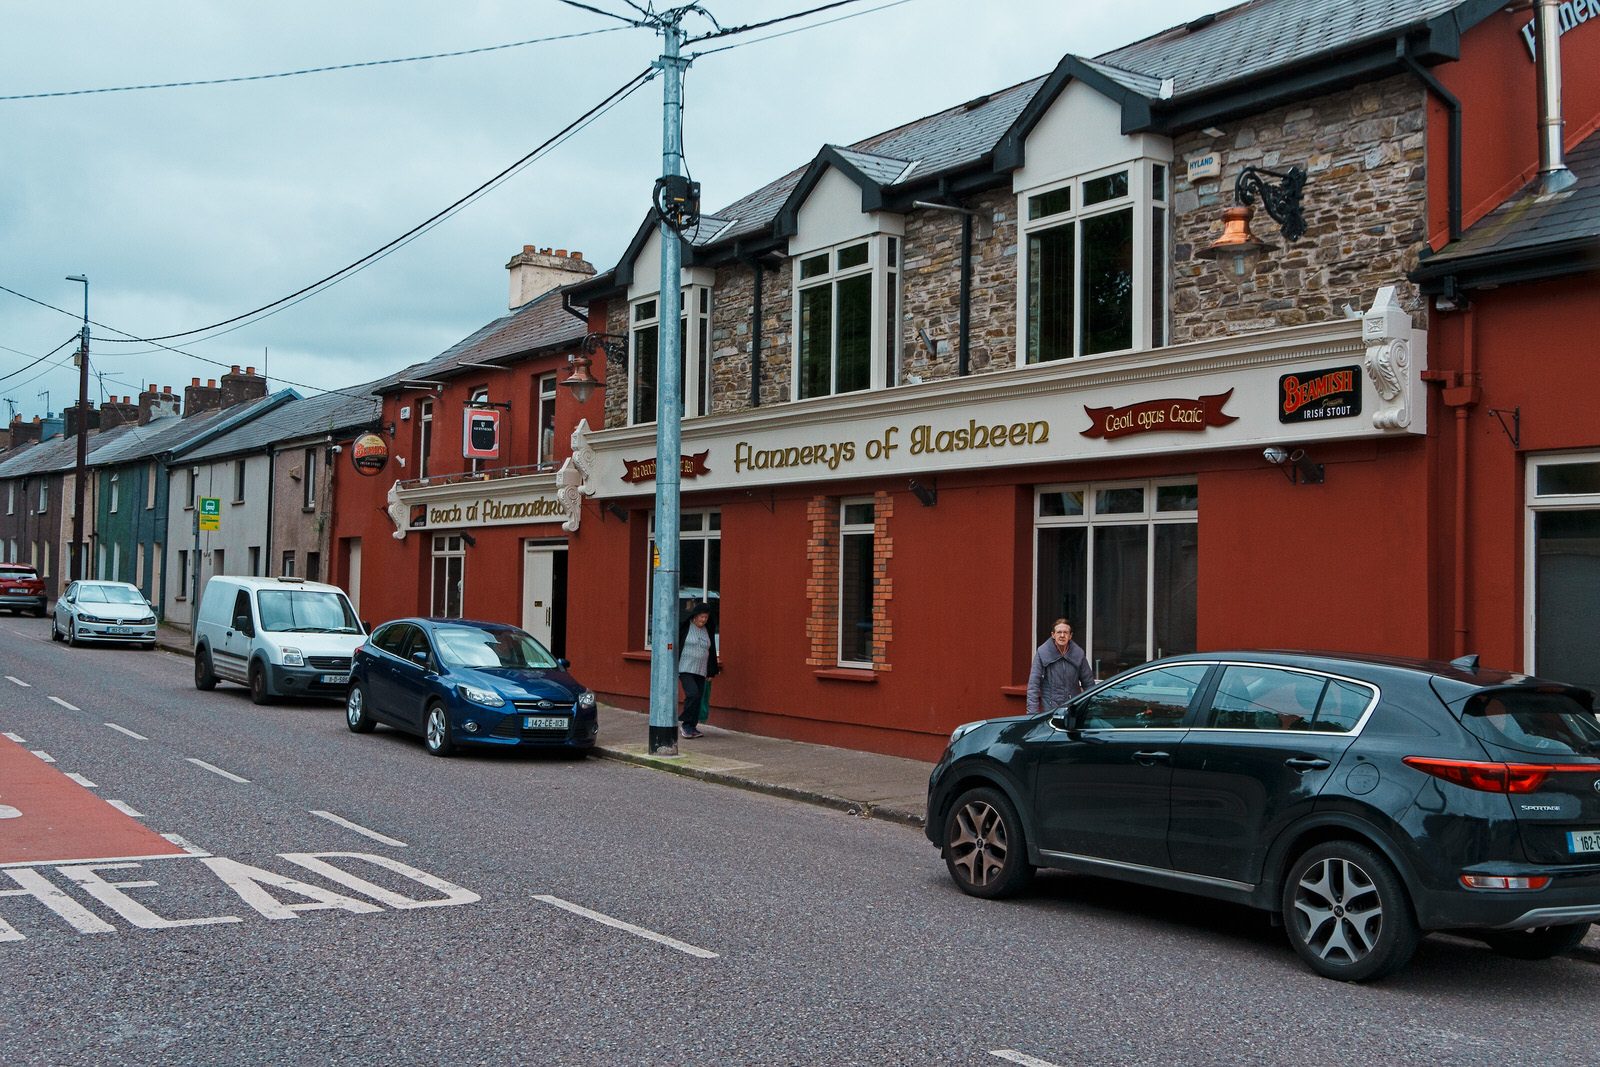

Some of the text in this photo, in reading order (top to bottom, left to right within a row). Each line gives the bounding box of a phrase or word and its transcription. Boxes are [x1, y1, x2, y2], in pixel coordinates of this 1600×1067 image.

[1190, 156, 1213, 169] HYLAND
[1283, 371, 1353, 415] BEAMISH
[1105, 411, 1134, 432] Ceoil
[1137, 410, 1165, 429] agus
[1303, 405, 1351, 419] IRISH STOUT
[865, 426, 899, 460] of
